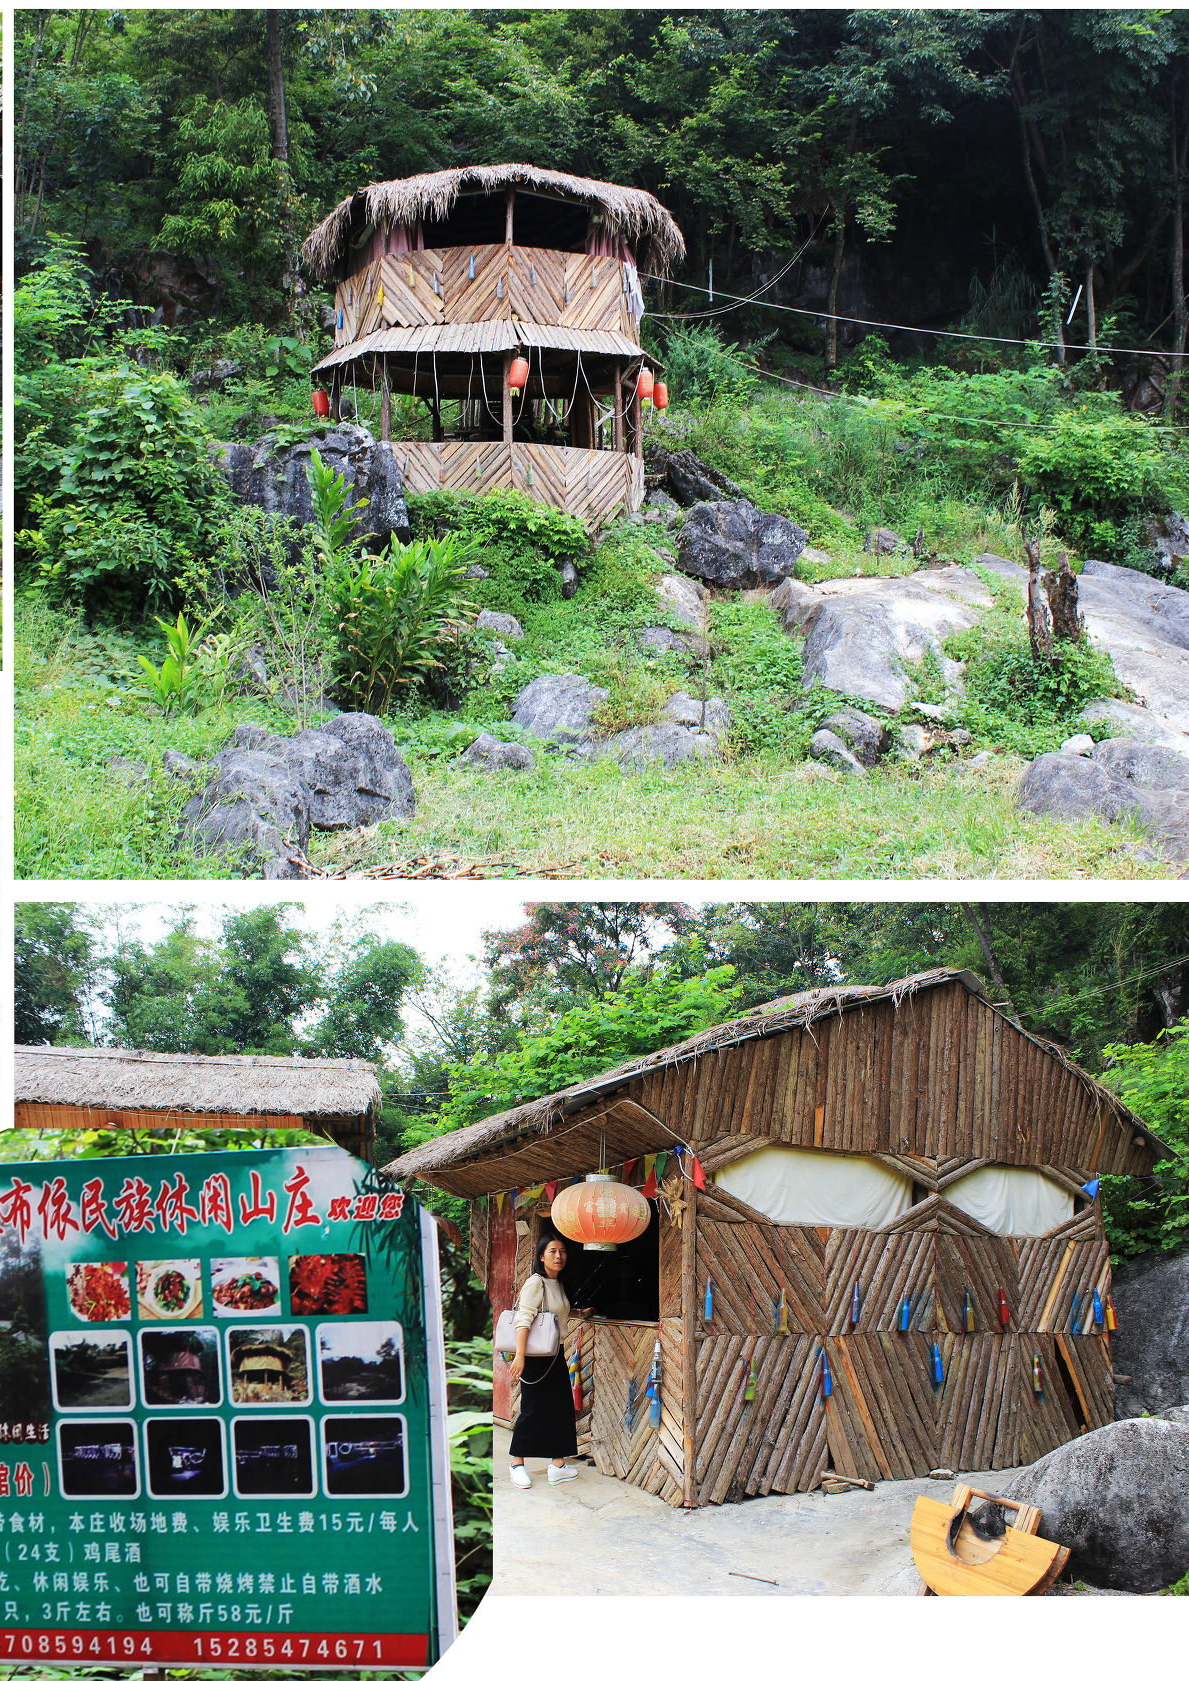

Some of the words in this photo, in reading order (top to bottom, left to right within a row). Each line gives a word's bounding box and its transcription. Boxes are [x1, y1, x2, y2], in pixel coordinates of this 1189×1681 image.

[326, 1194, 404, 1221] 欢迎您
[193, 1637, 382, 1659] 15285474671
